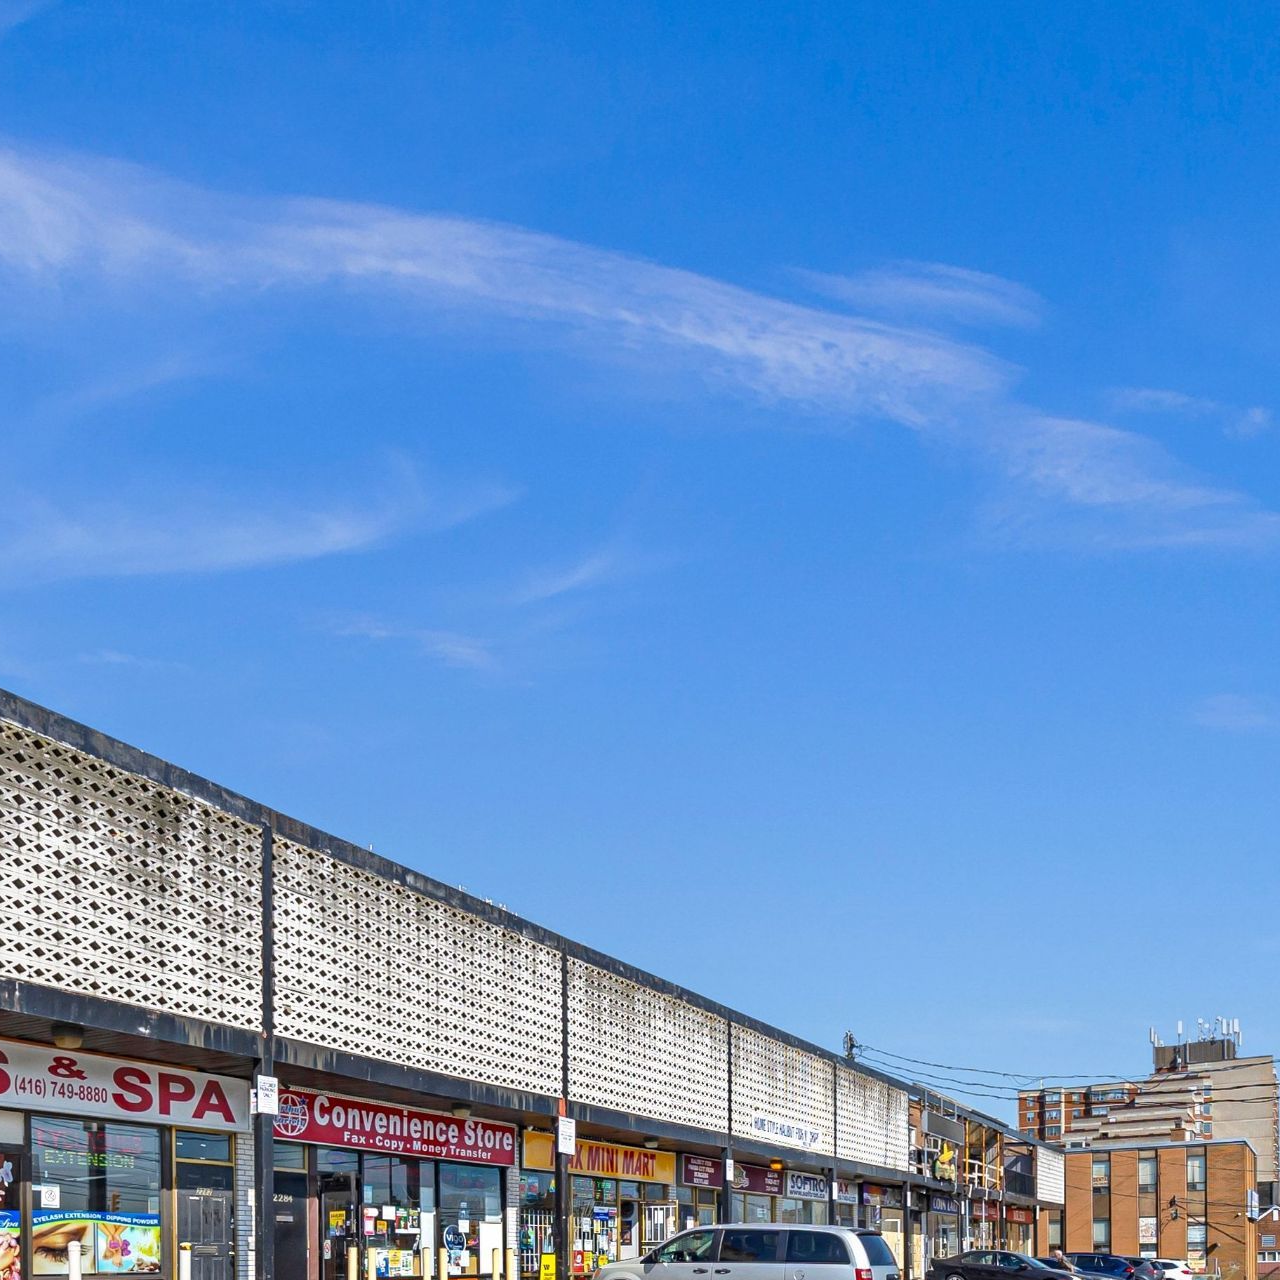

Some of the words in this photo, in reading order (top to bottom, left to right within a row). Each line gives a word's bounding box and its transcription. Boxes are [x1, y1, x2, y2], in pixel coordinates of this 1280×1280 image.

[14, 1074, 47, 1099] (416)
[50, 1081, 108, 1104] 749-8880
[48, 1056, 88, 1081] &
[112, 1066, 236, 1124] SPA
[313, 1095, 459, 1144] Convenience
[464, 1120, 513, 1151] Store
[44, 1149, 135, 1169] EXTENSION
[343, 1131, 366, 1144] Fax
[375, 1135, 405, 1150] Copy
[412, 1140, 448, 1156] Money
[449, 1145, 492, 1160] Transfer
[587, 1145, 619, 1173] MINI
[622, 1150, 657, 1177] MART
[272, 1193, 294, 1203] 2284
[32, 1212, 64, 1224] EYELASH
[64, 1211, 102, 1220] EXTENSION
[106, 1214, 132, 1224] DIPPING
[132, 1217, 159, 1226] POWDER
[446, 1230, 464, 1246] vigo
